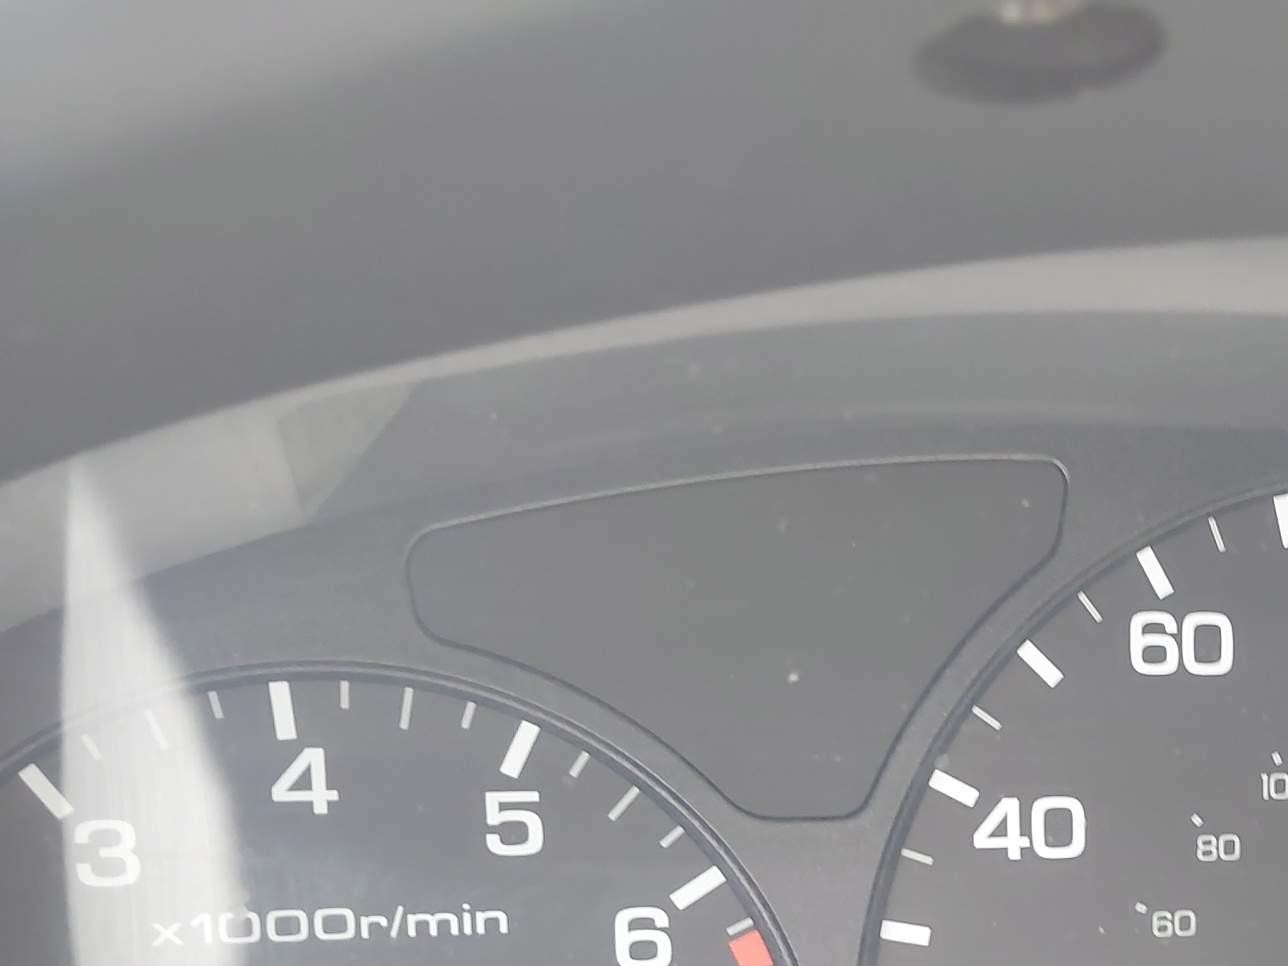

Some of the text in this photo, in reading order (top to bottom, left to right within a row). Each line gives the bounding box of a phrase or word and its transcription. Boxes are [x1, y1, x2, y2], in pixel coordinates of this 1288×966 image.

[1129, 611, 1234, 676] 60
[271, 747, 339, 815] 4
[75, 819, 142, 887] 3
[485, 790, 544, 856] 5
[973, 796, 1086, 861] 40
[1196, 834, 1241, 862] 80
[151, 903, 509, 948] x1000r/min
[1152, 910, 1196, 938] 60
